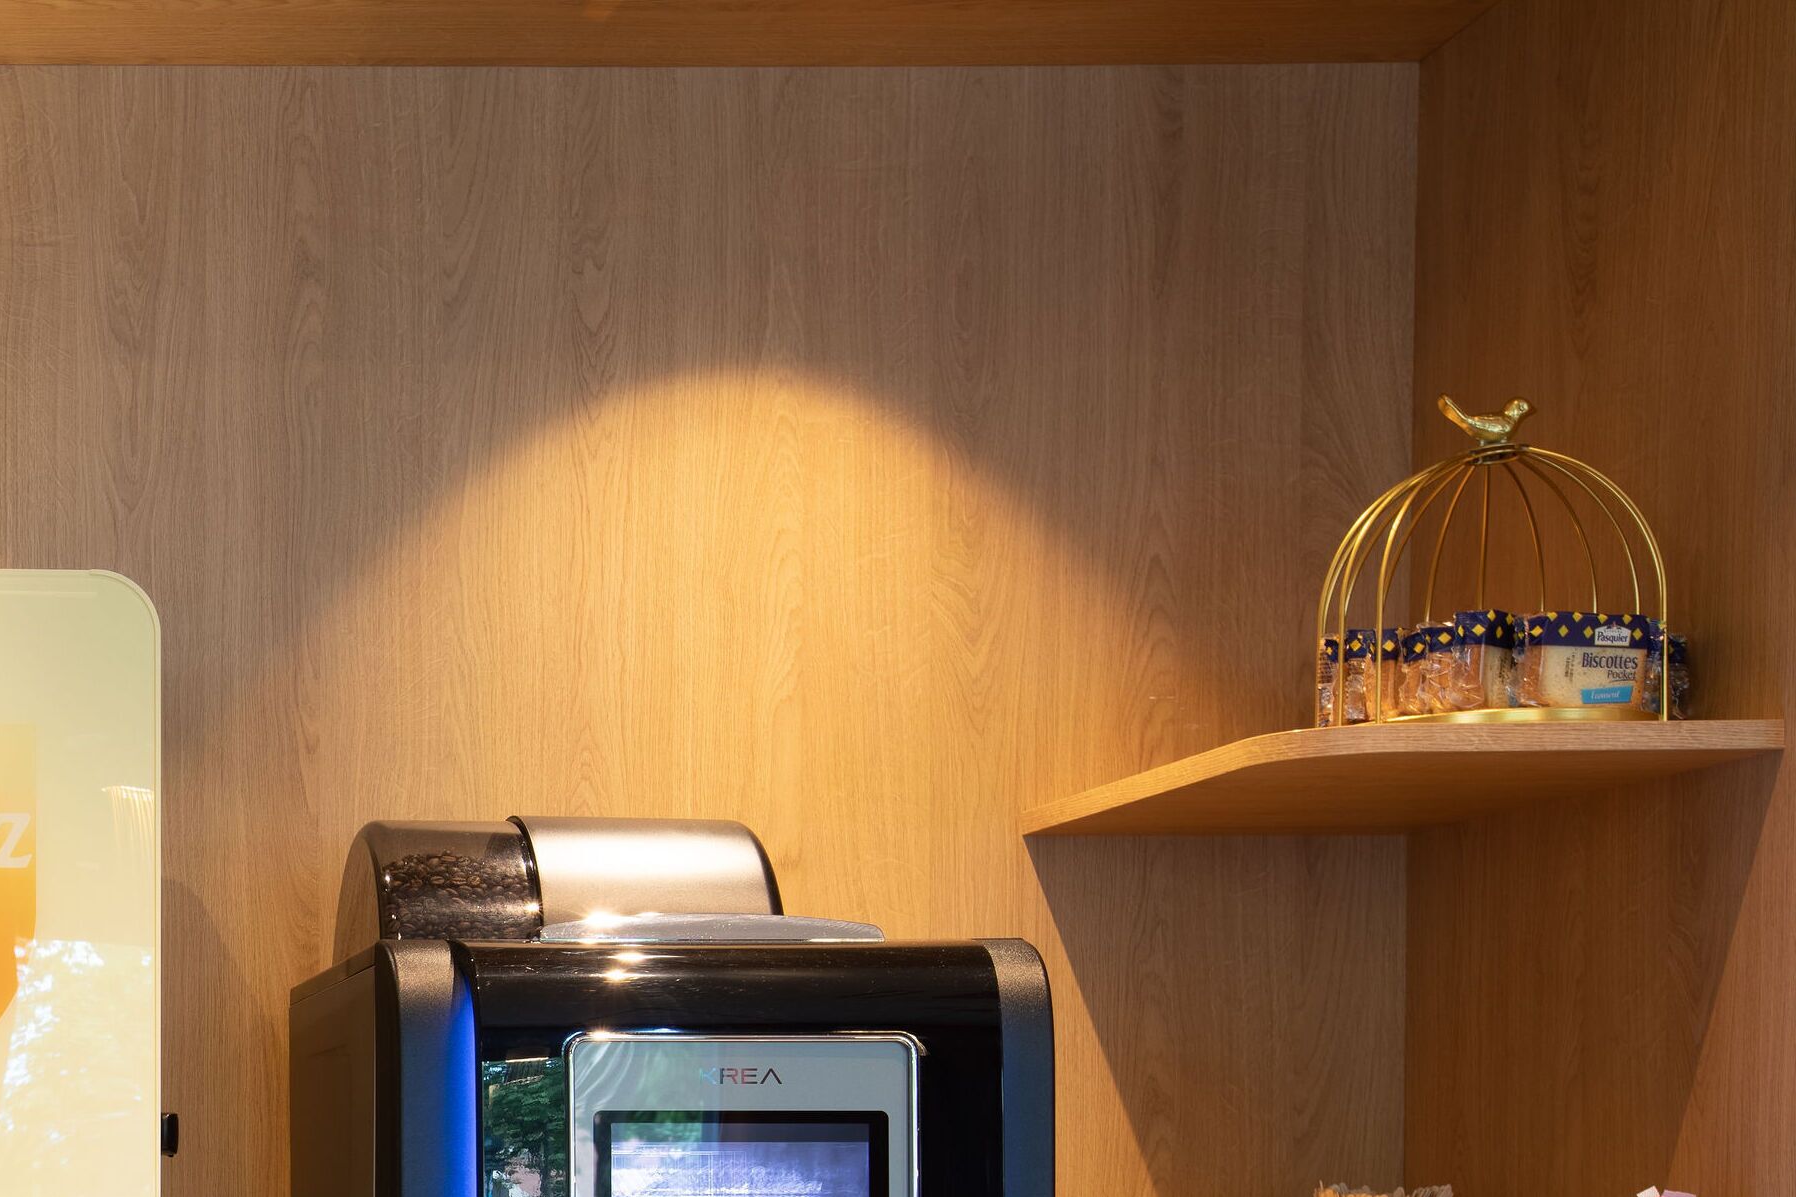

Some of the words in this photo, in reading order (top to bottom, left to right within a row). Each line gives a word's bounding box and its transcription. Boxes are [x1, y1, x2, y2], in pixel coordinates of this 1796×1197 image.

[1597, 631, 1629, 644] Pasquier
[1581, 651, 1638, 669] Biscottes
[1607, 670, 1637, 680] Pocket
[699, 1067, 783, 1085] KREA
